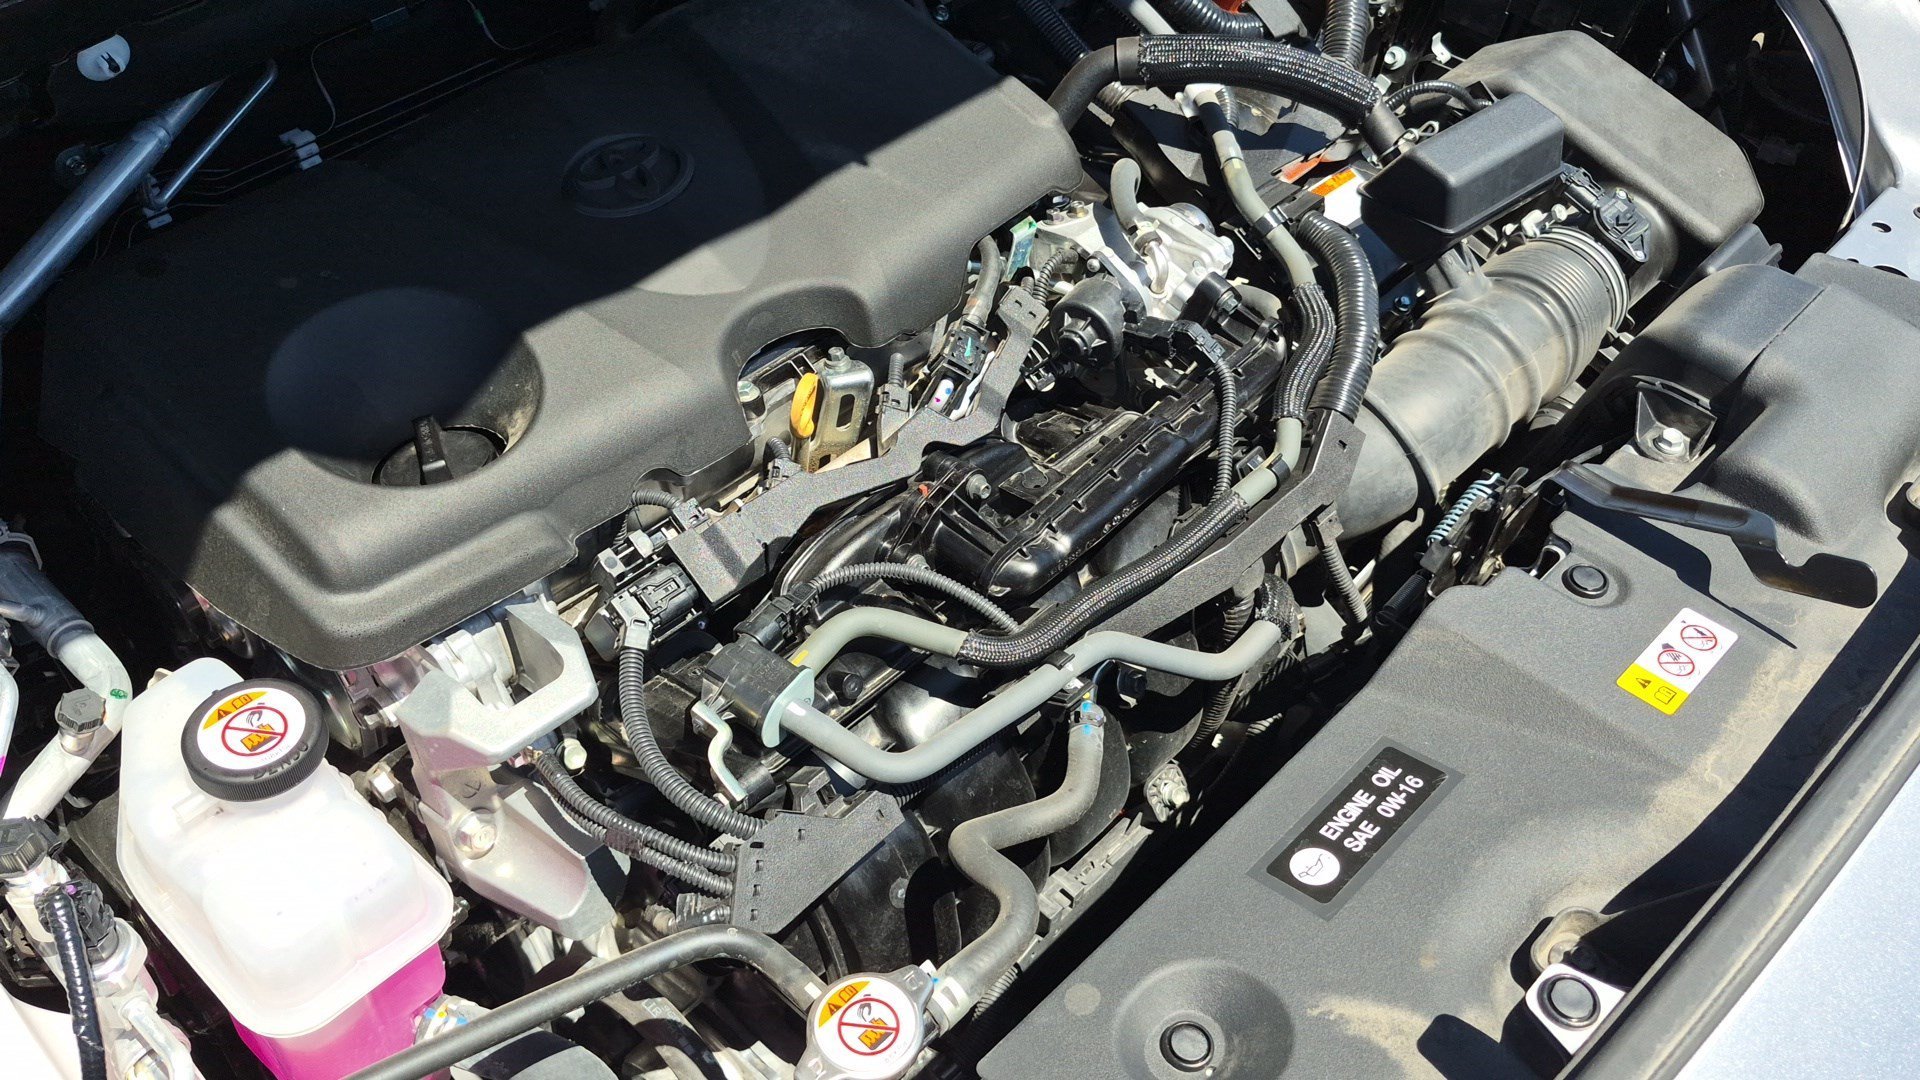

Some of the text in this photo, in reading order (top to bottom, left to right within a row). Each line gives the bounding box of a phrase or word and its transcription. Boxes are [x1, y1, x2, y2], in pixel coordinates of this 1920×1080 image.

[253, 741, 309, 780] DENSO
[1318, 766, 1403, 841] ENGINE OIL
[1343, 775, 1424, 852] SAE 0W-16
